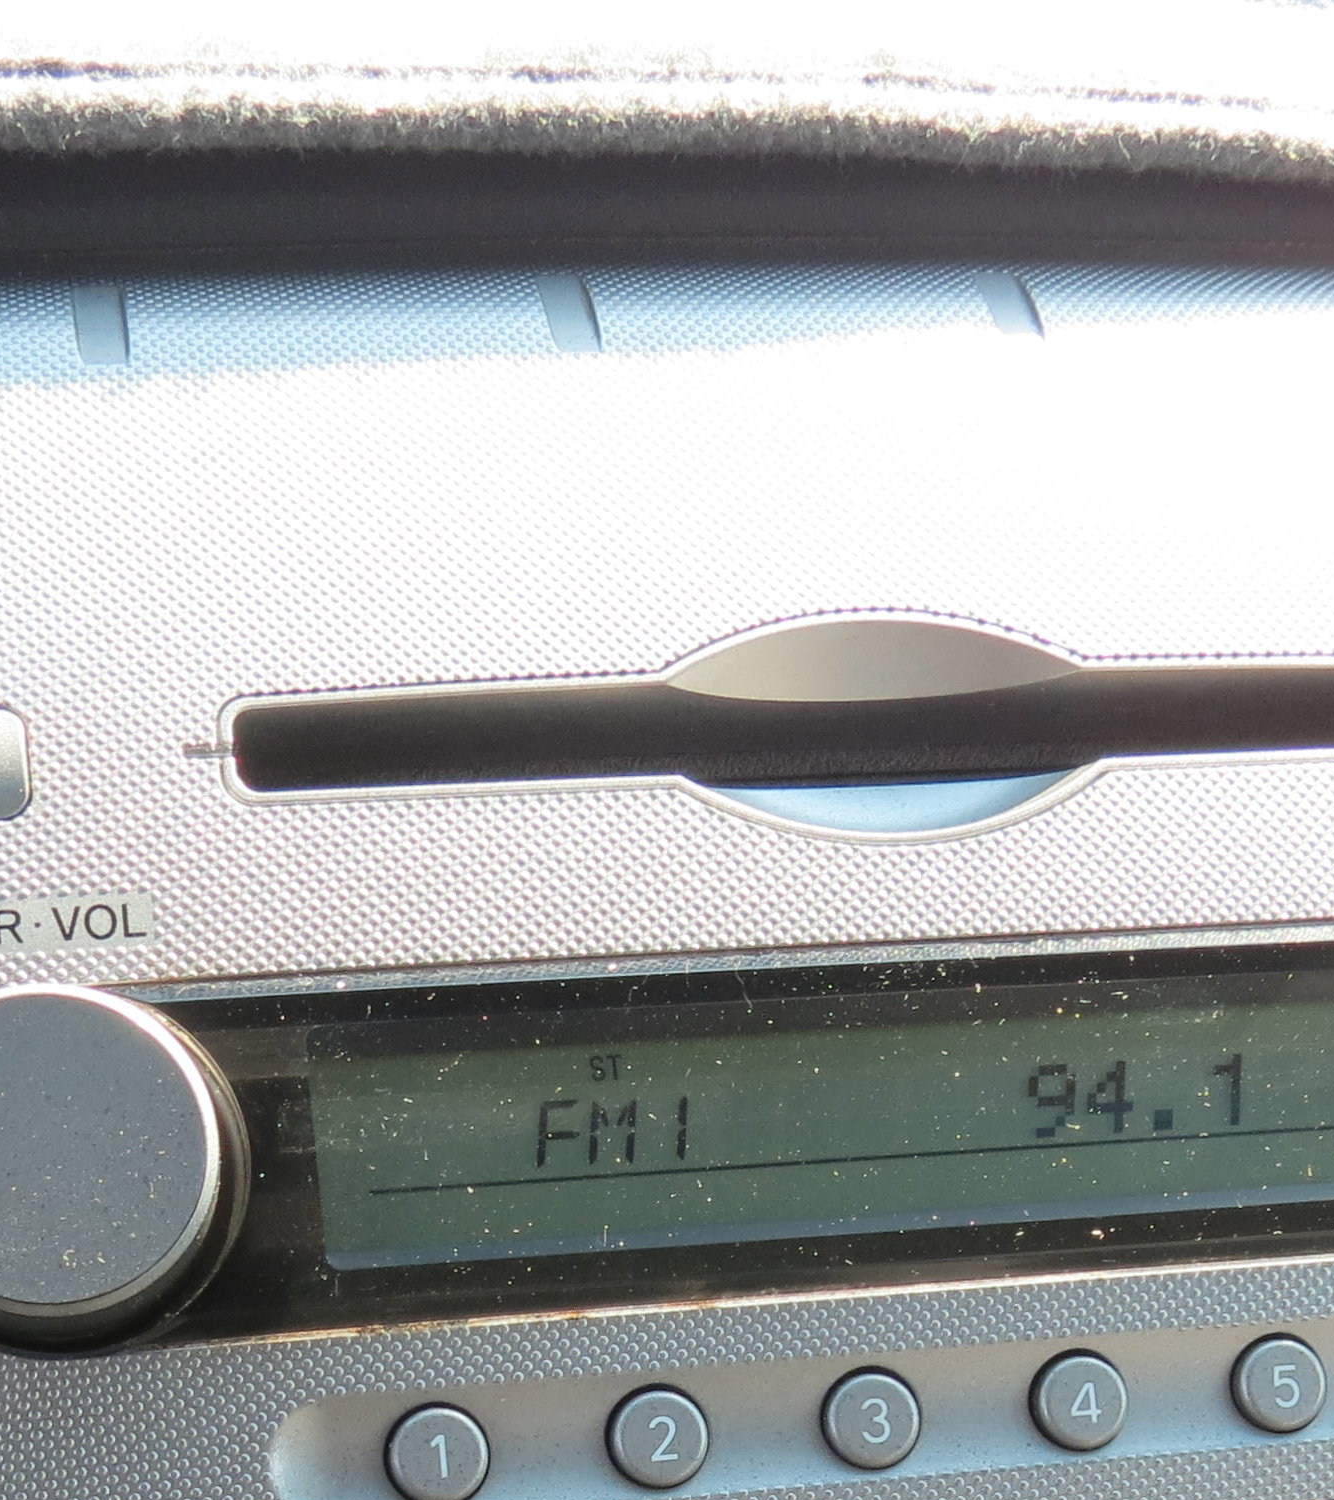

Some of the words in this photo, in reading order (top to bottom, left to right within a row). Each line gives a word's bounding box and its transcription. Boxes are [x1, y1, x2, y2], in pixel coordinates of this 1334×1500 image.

[589, 1054, 622, 1082] ST
[1027, 1052, 1243, 1139] 94.1
[1069, 1381, 1103, 1425] 4
[1271, 1363, 1302, 1409] 5
[648, 1415, 680, 1463] 2
[860, 1397, 892, 1444] 3
[429, 1433, 451, 1480] 1
